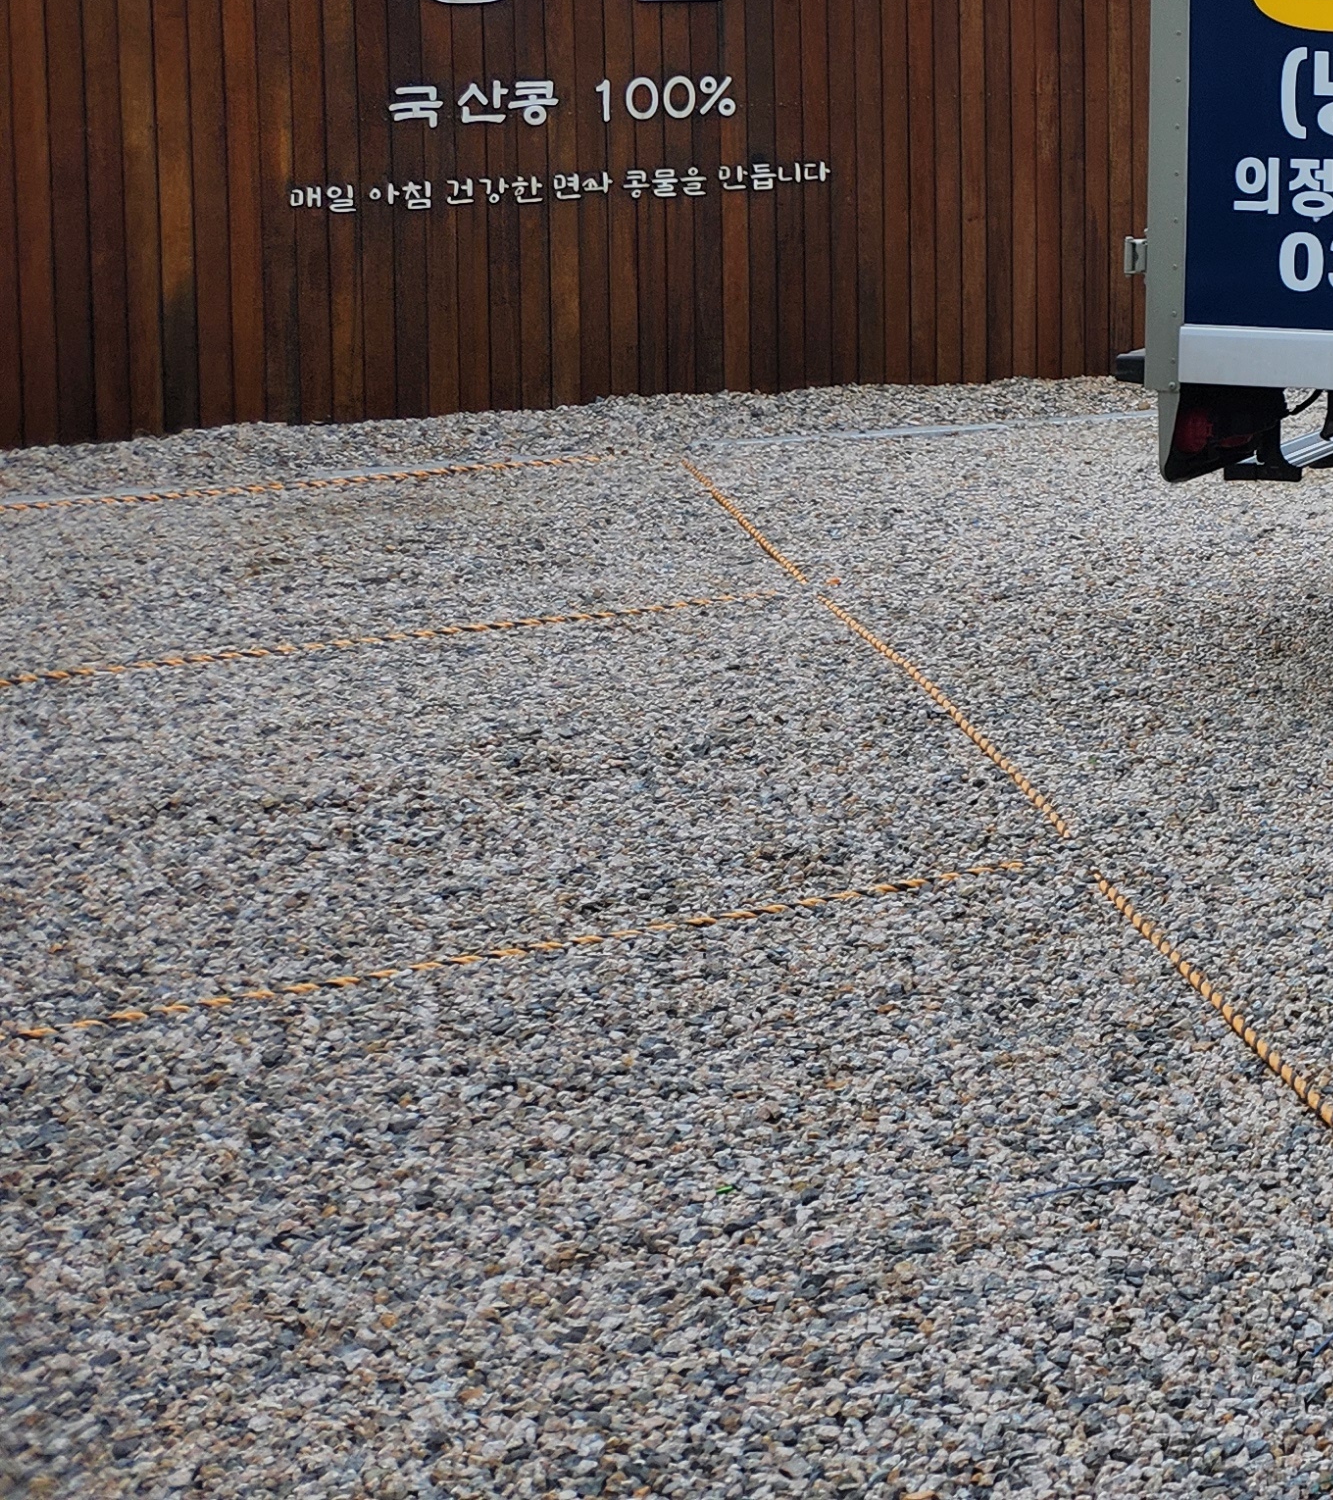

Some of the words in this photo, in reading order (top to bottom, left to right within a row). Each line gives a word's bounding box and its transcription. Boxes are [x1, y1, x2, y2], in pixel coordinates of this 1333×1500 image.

[388, 80, 559, 128] 국산콩
[595, 75, 736, 122] 100%
[289, 184, 358, 213] 매일
[368, 180, 433, 210] 아침
[446, 176, 543, 205] 건강한
[622, 166, 708, 198] 콩물을
[718, 161, 832, 191] 만듭니다
